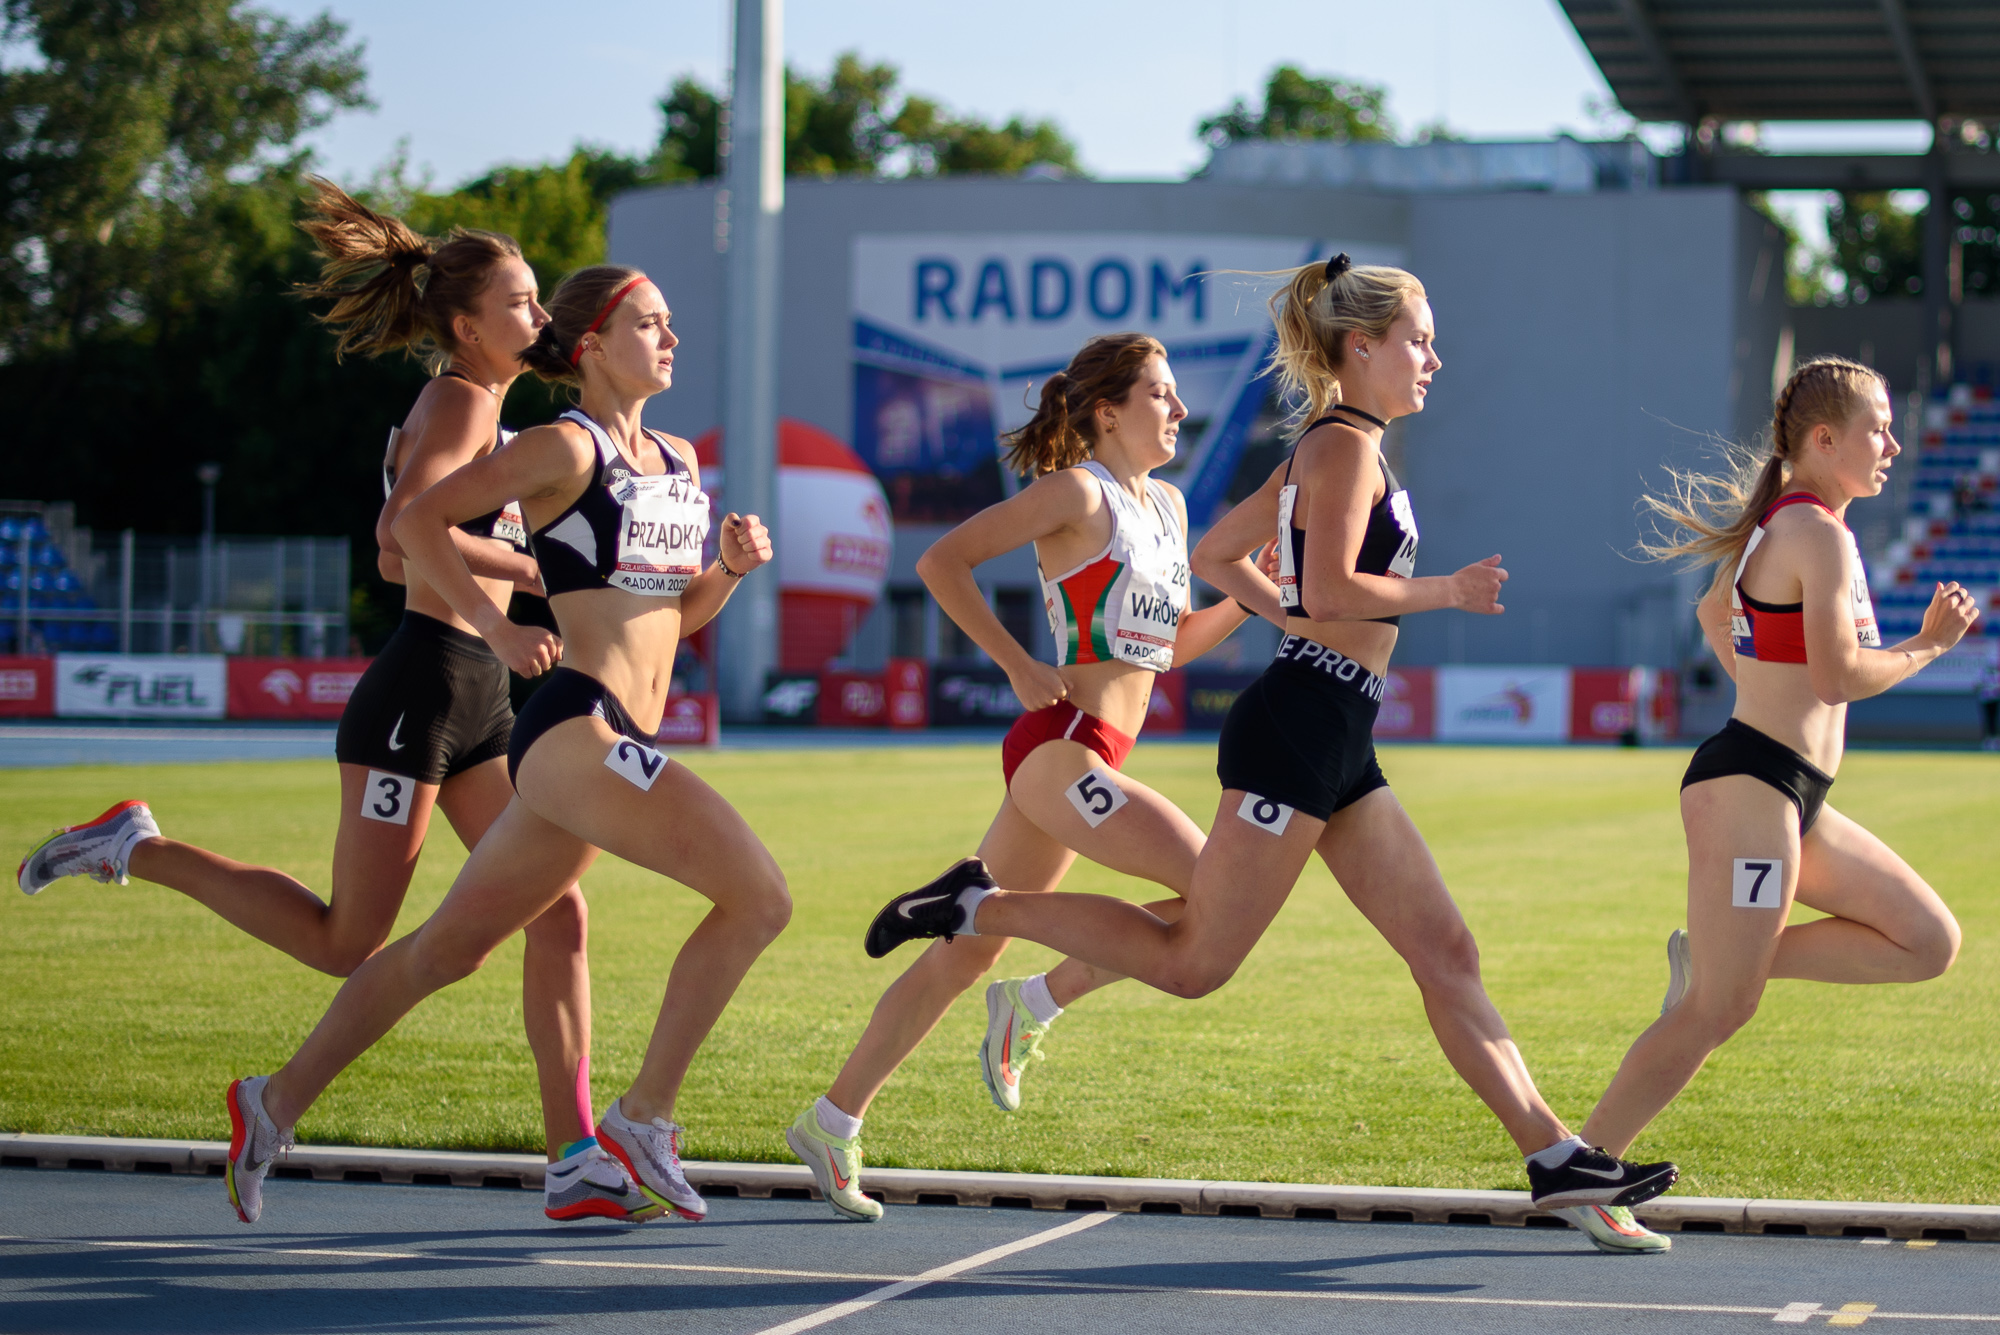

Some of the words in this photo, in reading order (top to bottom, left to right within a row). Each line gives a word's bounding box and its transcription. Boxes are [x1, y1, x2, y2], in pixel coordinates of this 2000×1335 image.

[913, 260, 1208, 322] RADOM
[626, 520, 704, 554] PRZĄDKA
[622, 576, 665, 591] RADOM
[1293, 640, 1360, 682] PRO
[106, 673, 208, 707] FUEL
[618, 741, 663, 780] 2
[373, 777, 402, 818] 3
[1077, 773, 1113, 815] 5
[1744, 862, 1772, 903] 7
